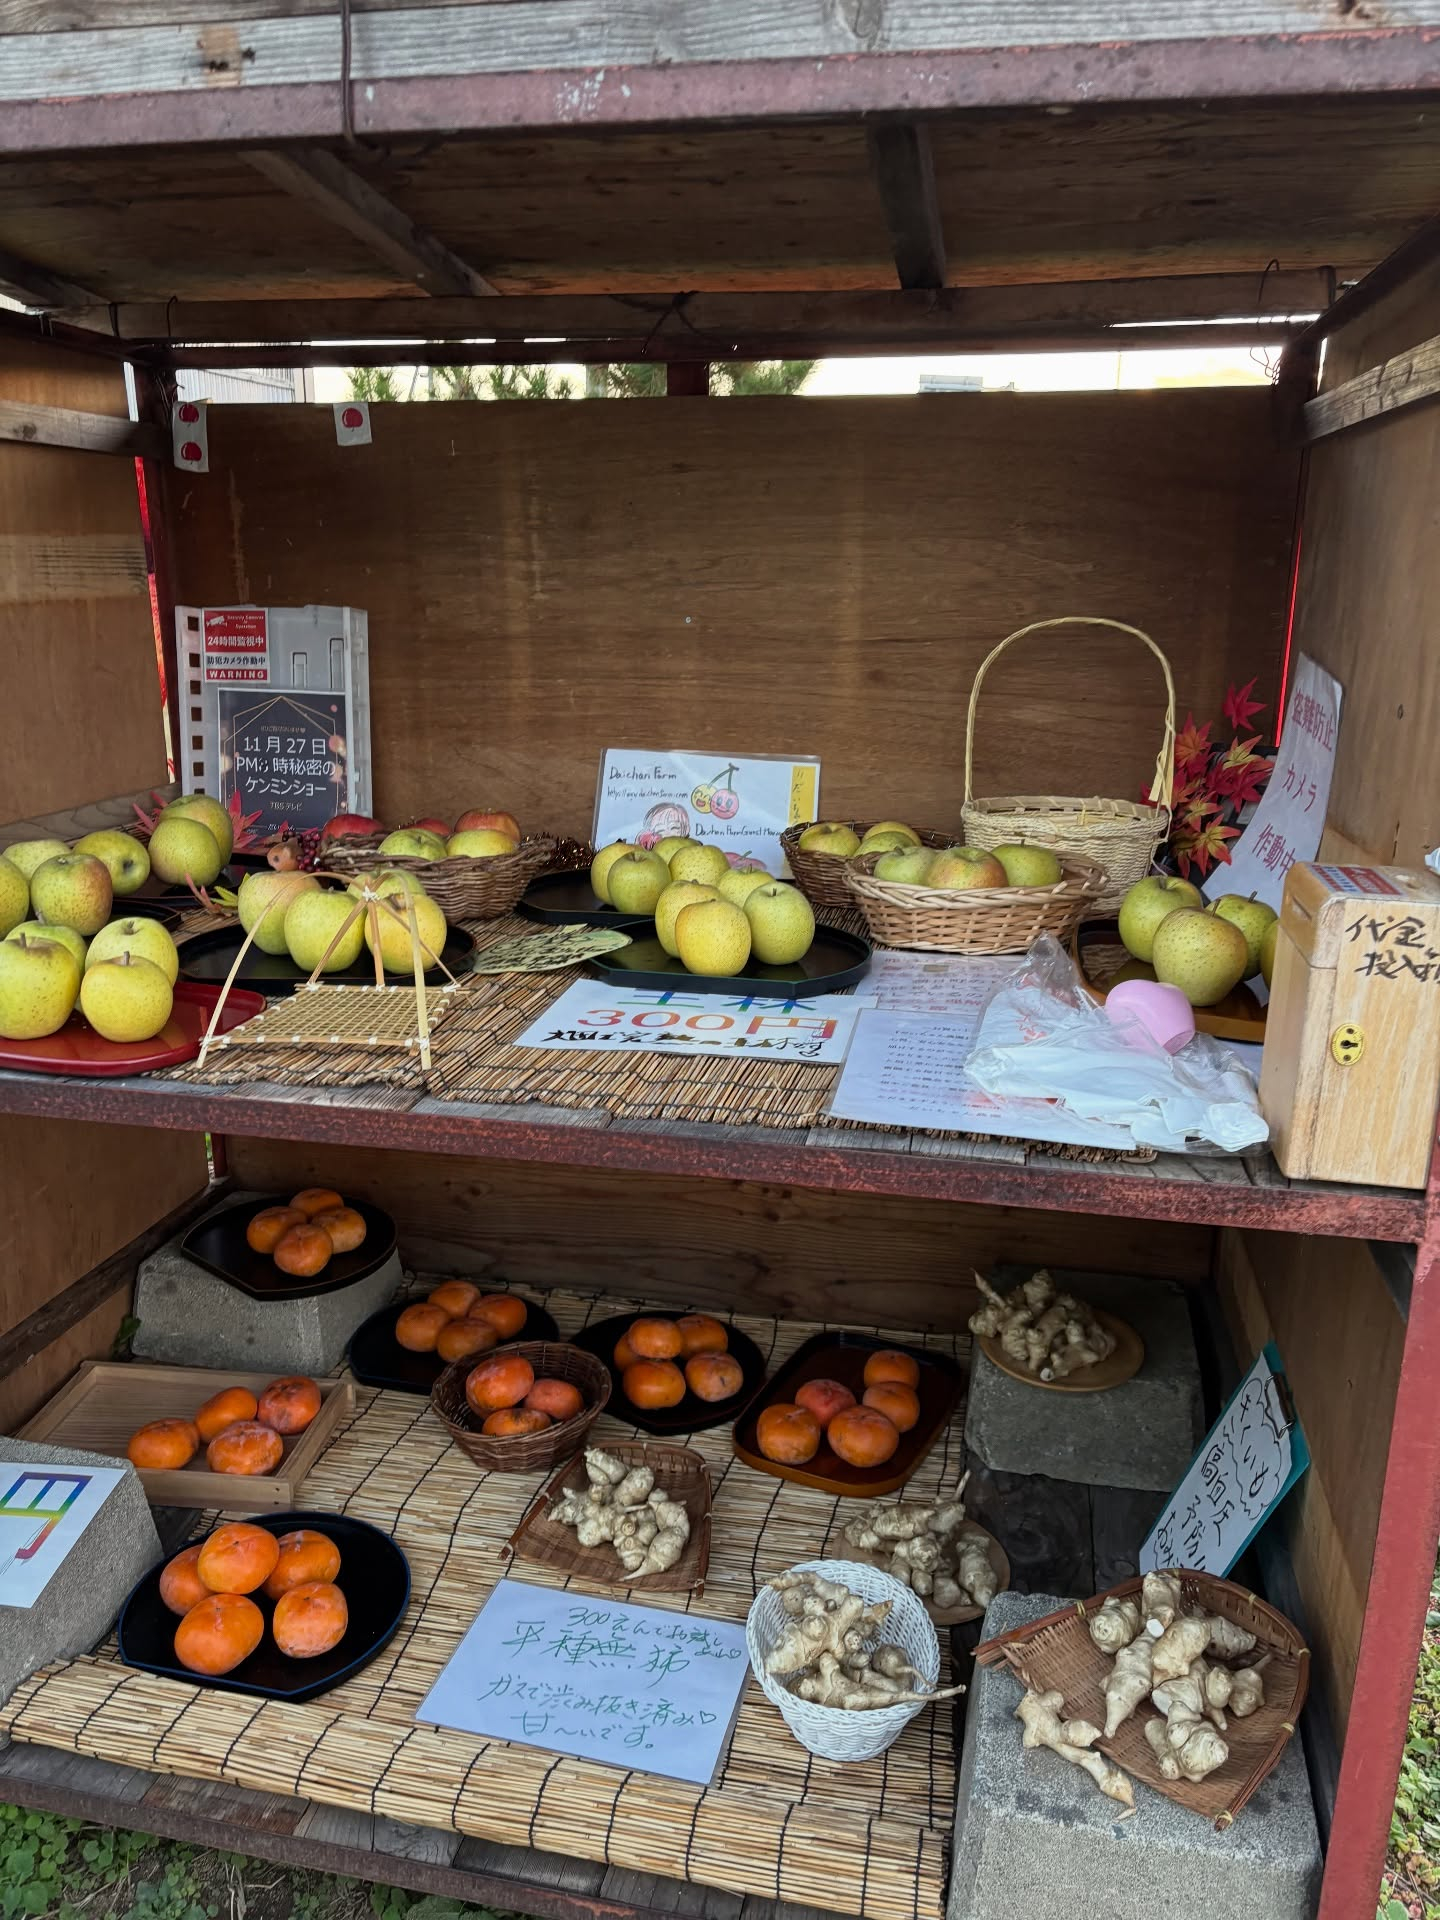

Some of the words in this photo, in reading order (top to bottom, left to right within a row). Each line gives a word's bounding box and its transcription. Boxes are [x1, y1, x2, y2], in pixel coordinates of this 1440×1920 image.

[208, 635, 264, 648] 24時間監視中
[207, 655, 266, 665] 防犯カメラ作動中
[209, 670, 264, 679] WARNING
[1292, 688, 1334, 753] 盗難防止
[245, 776, 327, 796] ケンミンショー
[1282, 763, 1317, 813] カメラ
[1252, 823, 1297, 881] 作動中
[577, 1008, 839, 1040] 300円
